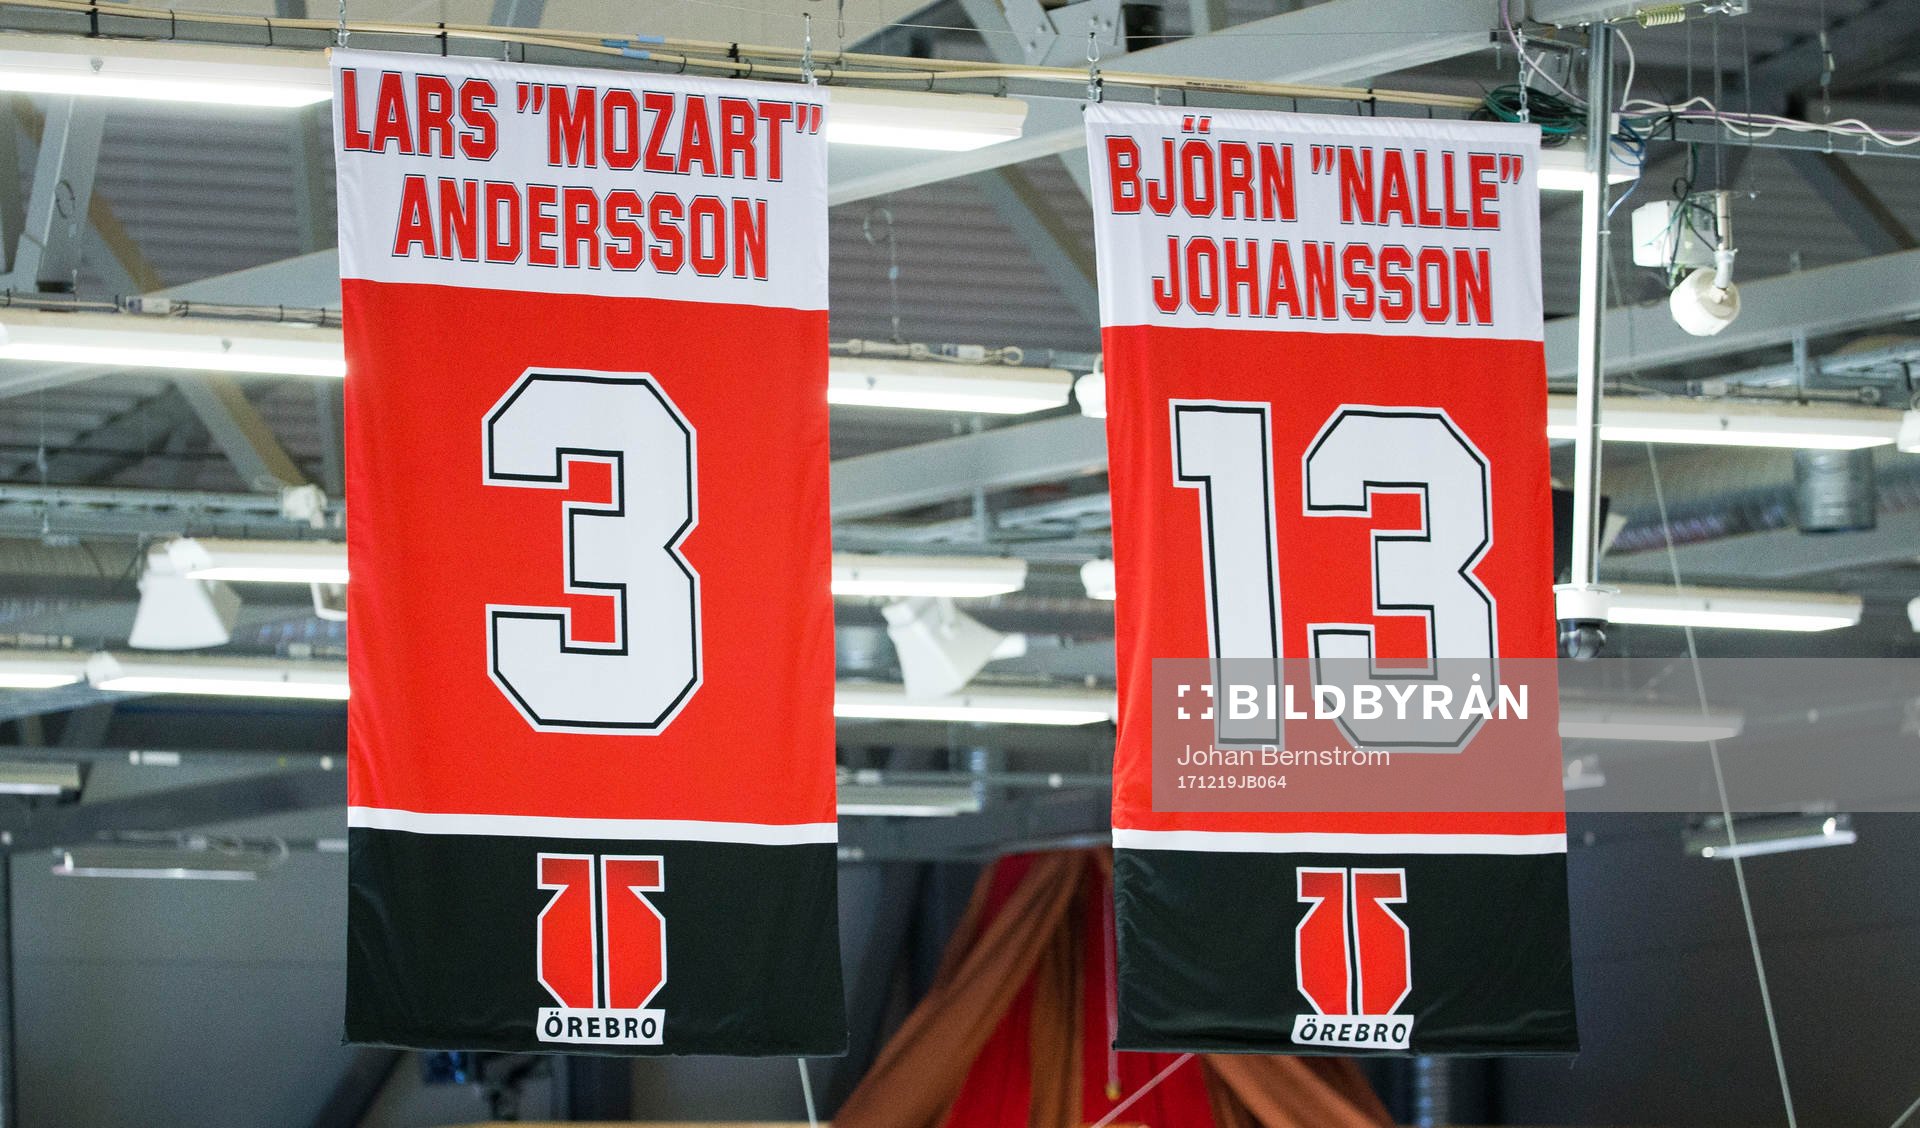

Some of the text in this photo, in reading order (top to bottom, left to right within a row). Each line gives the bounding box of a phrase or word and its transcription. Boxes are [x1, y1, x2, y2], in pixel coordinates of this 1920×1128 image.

[340, 67, 498, 161] LARS
[1105, 115, 1297, 222] BJÖRN
[391, 173, 769, 281] ANDERSSON
[1151, 235, 1494, 326] JOHANSSON
[481, 366, 705, 736] 3
[1168, 398, 1500, 754] 13
[544, 1010, 657, 1038] ÖREBRO
[1299, 1017, 1407, 1043] ÖREBRO
